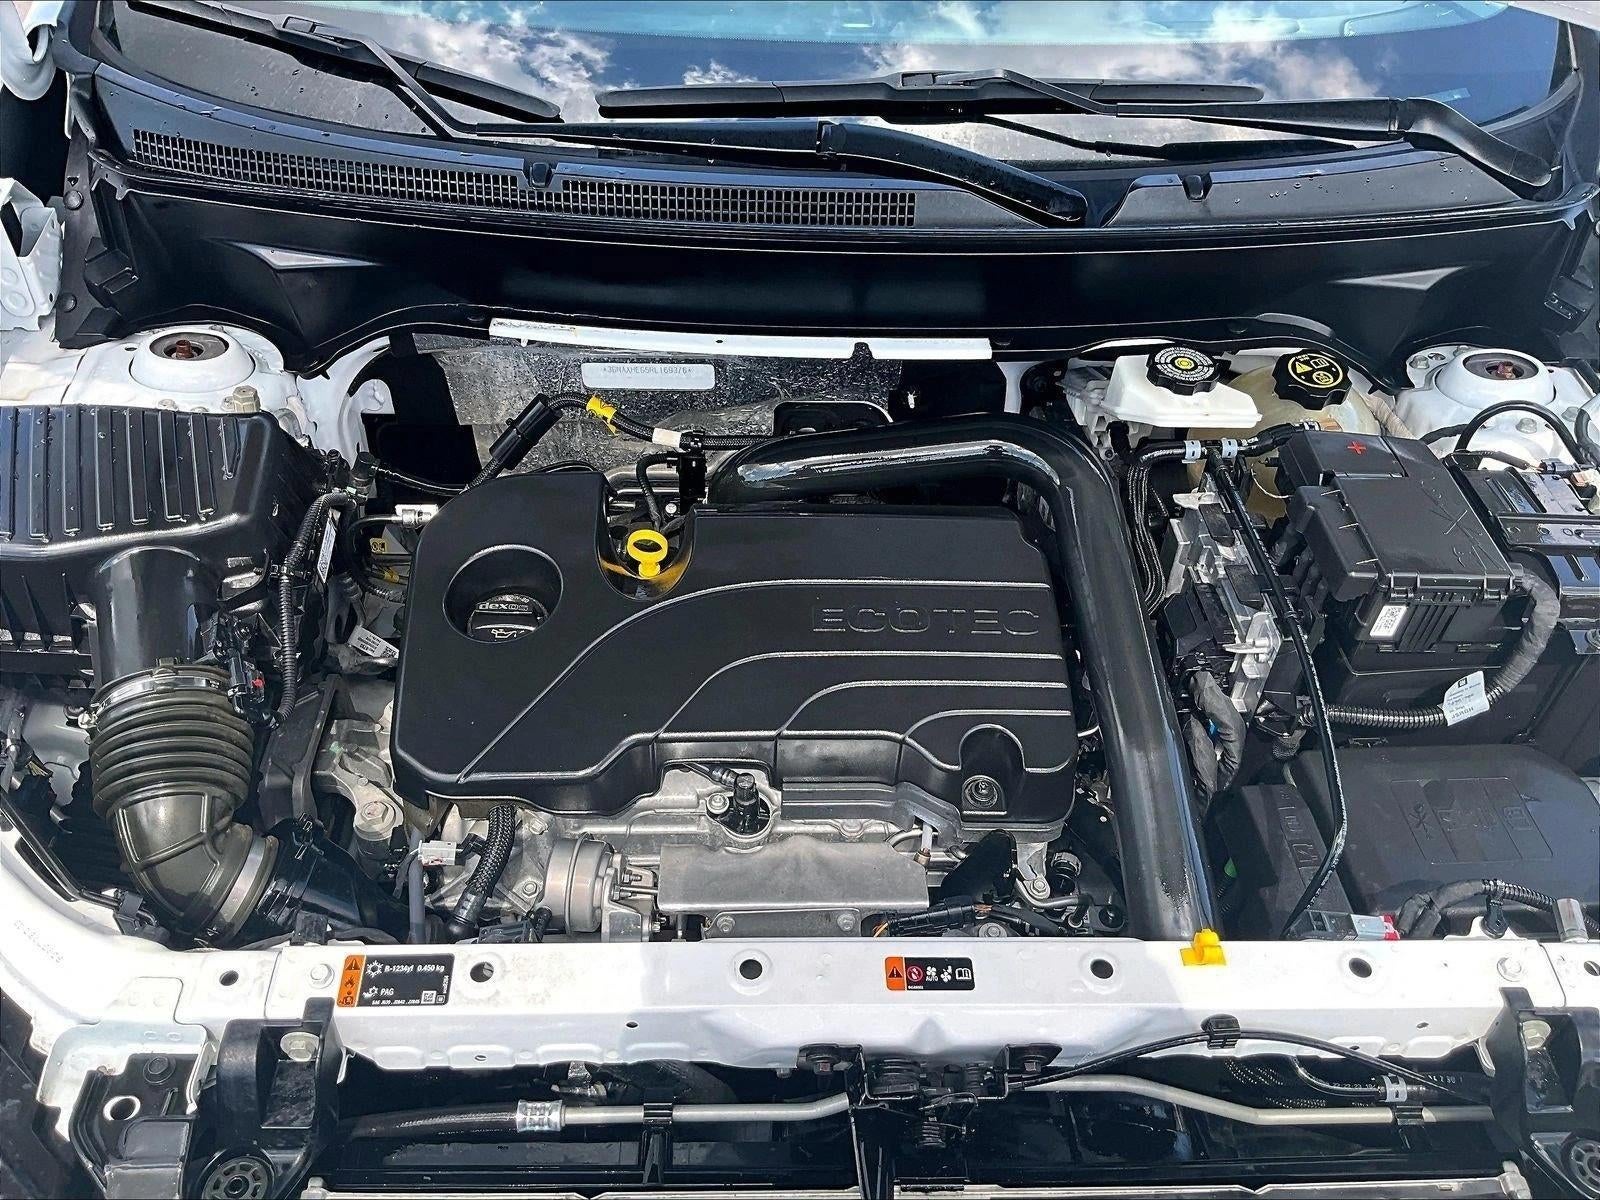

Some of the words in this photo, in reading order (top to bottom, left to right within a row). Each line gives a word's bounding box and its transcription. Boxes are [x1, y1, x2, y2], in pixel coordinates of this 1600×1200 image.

[812, 606, 1039, 635] ECOTEC
[436, 964, 445, 973] kg
[380, 988, 394, 996] PAG
